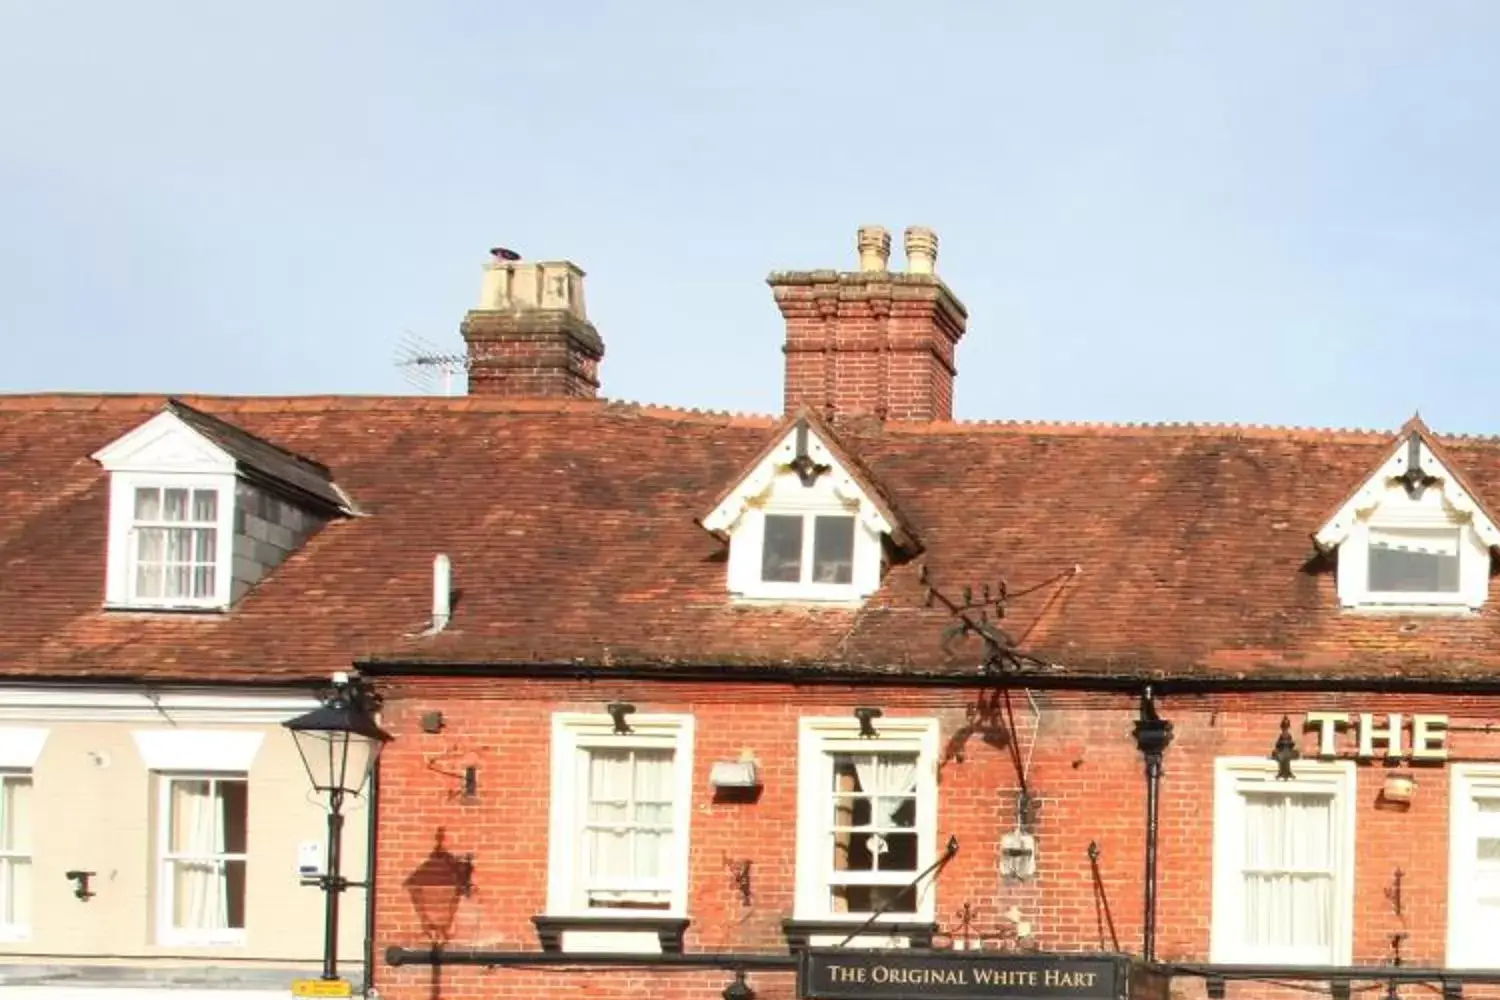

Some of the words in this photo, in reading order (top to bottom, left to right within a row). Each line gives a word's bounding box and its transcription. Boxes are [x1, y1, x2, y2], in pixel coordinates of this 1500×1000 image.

[1308, 711, 1448, 758] THE
[827, 965, 865, 983] THE
[871, 965, 968, 985] ORIGINAL
[973, 969, 1038, 987] WHITE
[1044, 970, 1097, 988] HART
